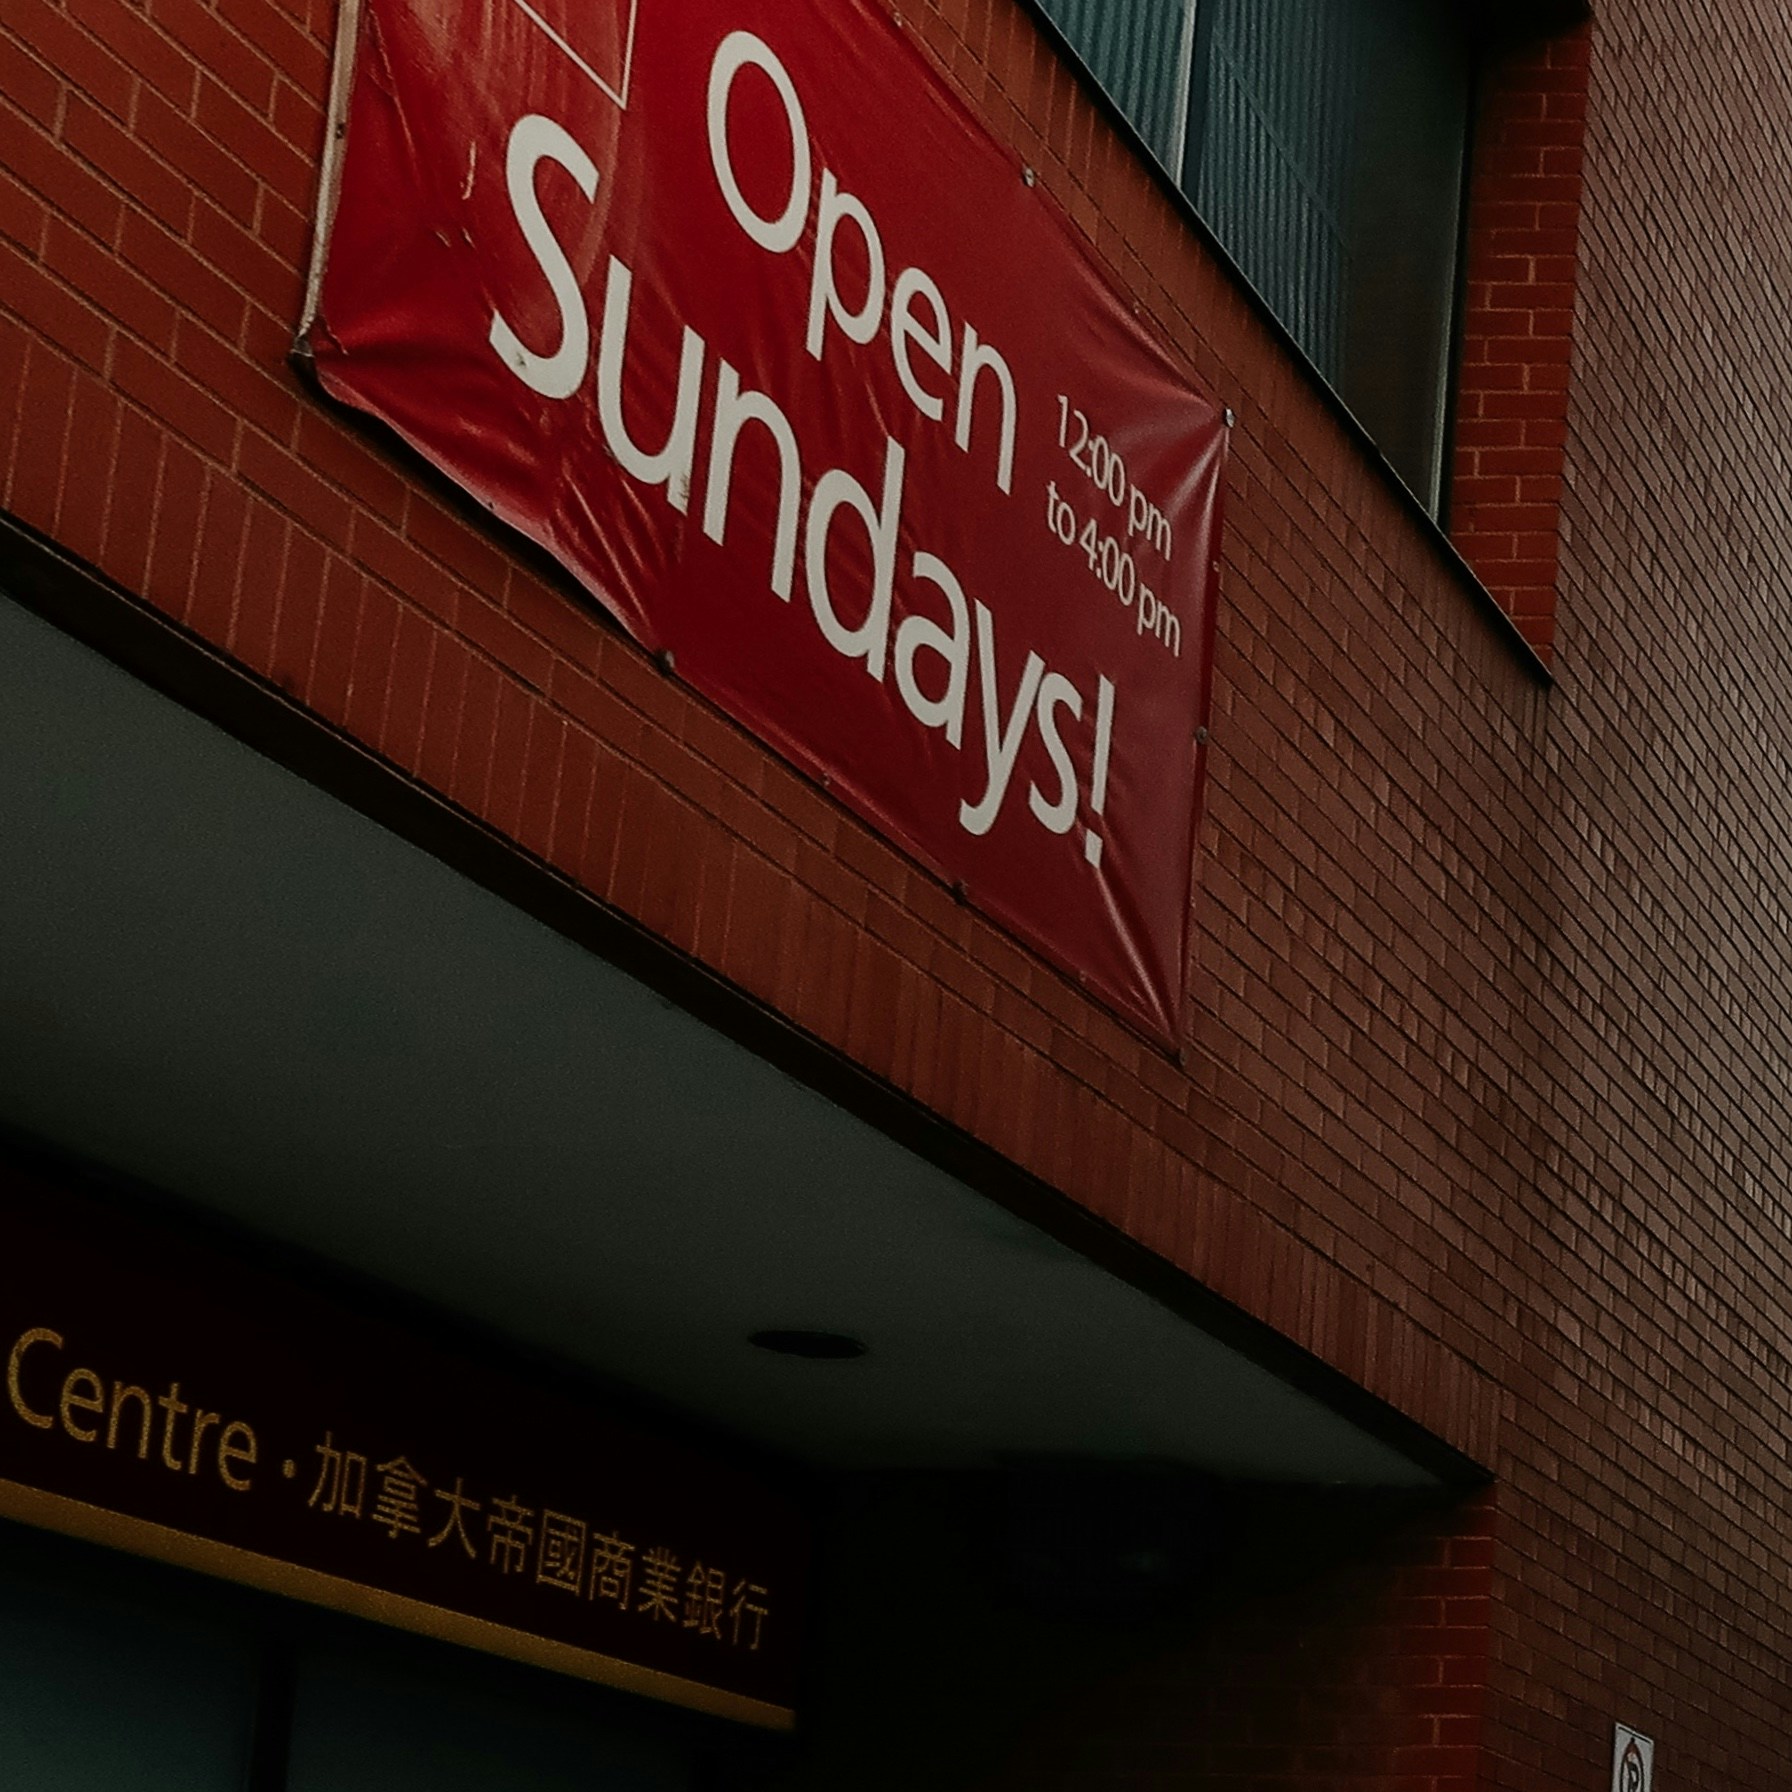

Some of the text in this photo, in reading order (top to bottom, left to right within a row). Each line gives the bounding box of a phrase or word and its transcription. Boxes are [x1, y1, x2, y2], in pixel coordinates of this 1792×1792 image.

[708, 31, 1015, 494] Open
[488, 114, 1114, 868] Sundays!
[1047, 480, 1180, 657] to 4:00 pm
[1058, 394, 1172, 561] 12:00 pm
[8, 1327, 257, 1491] Centre
[307, 1430, 767, 1651] 加拿大帝國商業銀行
